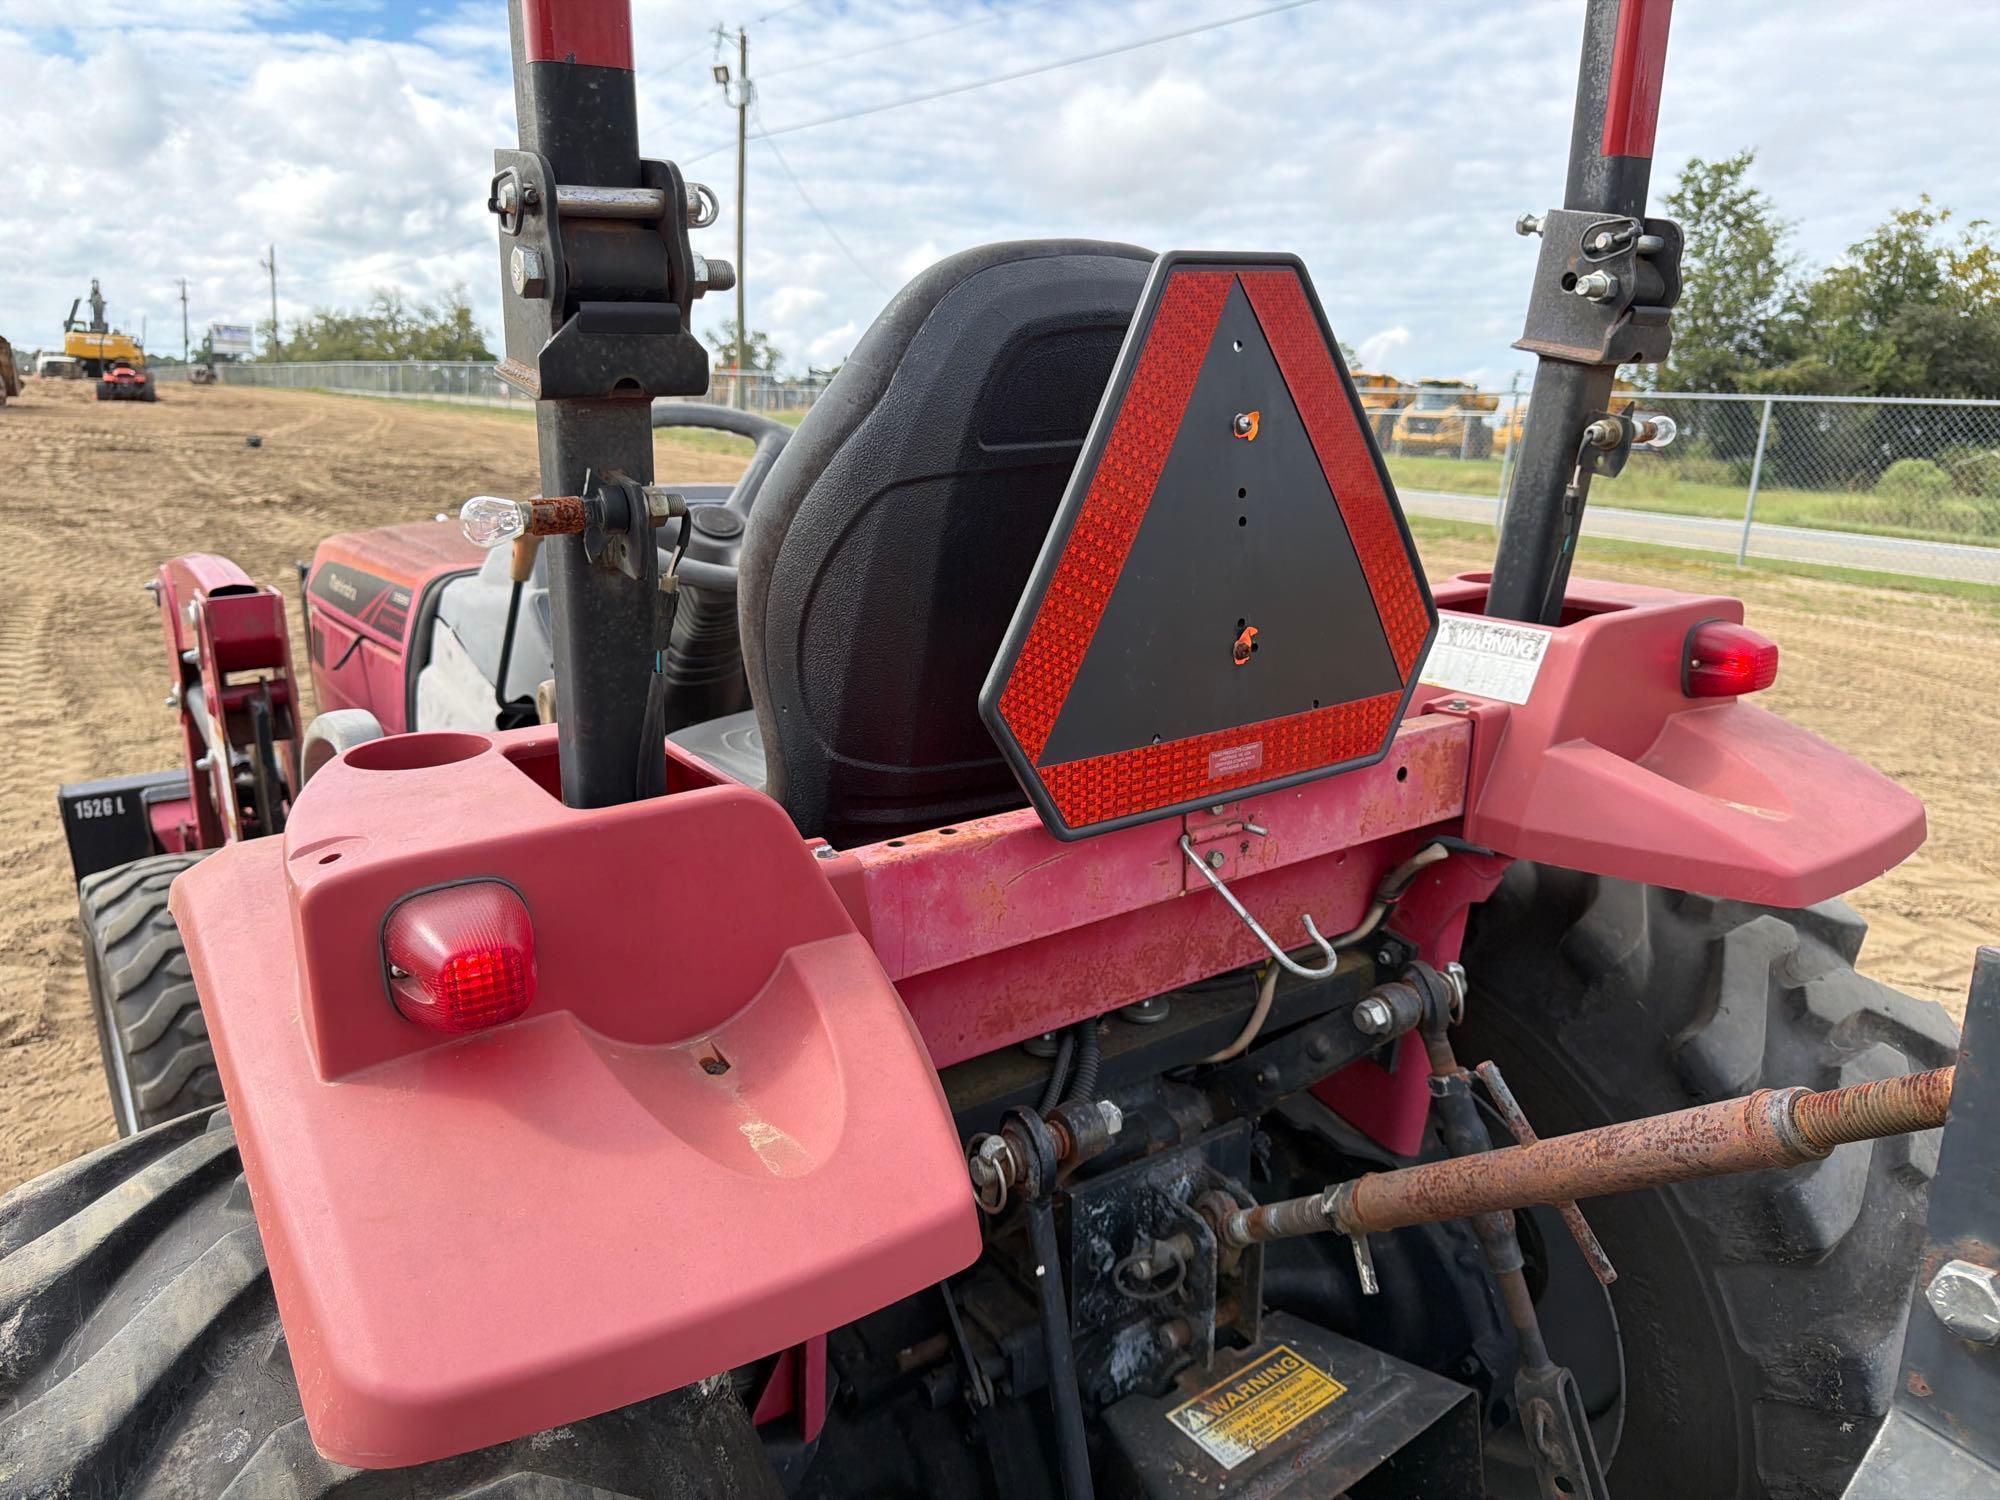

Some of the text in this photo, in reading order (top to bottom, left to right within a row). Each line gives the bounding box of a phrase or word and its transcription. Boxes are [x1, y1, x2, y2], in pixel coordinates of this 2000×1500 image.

[1455, 627, 1537, 660] WARNING
[116, 796, 126, 816] L
[1205, 1355, 1298, 1417] WARNING
